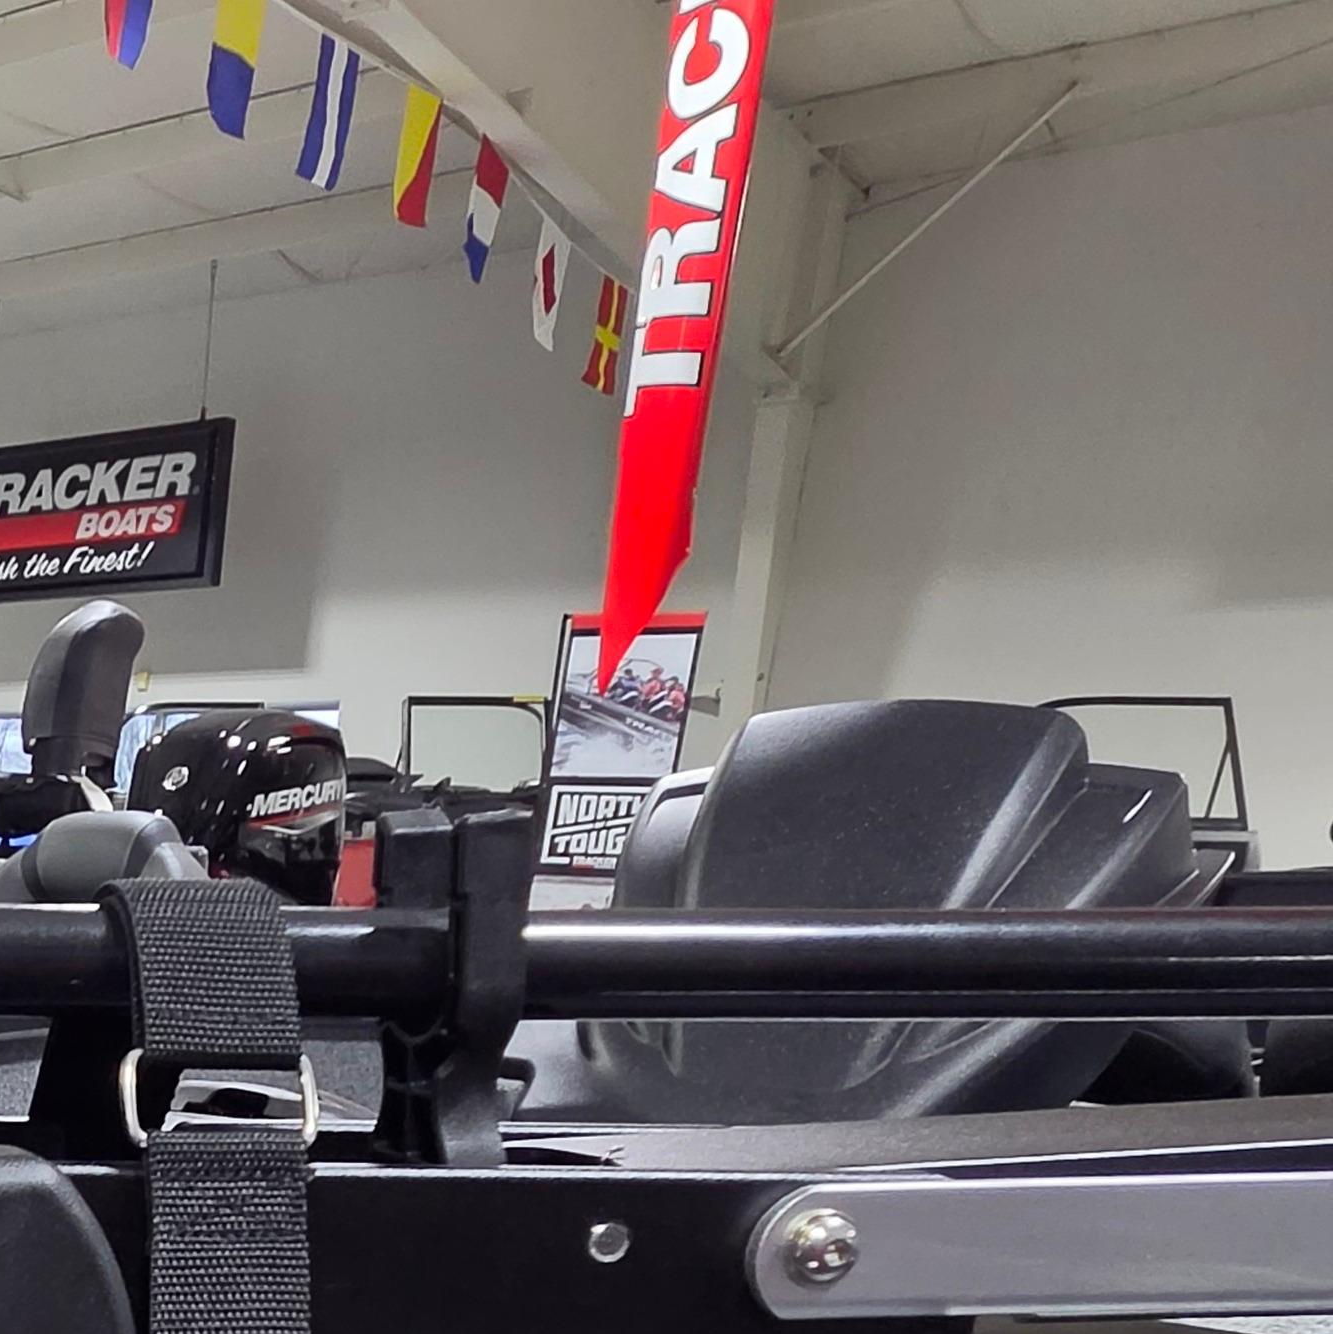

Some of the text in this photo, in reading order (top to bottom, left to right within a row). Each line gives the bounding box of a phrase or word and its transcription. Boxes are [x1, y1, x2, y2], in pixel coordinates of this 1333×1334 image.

[623, 0, 751, 417] TRAC
[75, 504, 176, 540] BOATS
[23, 550, 60, 580] the
[63, 541, 155, 575] Finest!
[553, 826, 627, 855] TOUG
